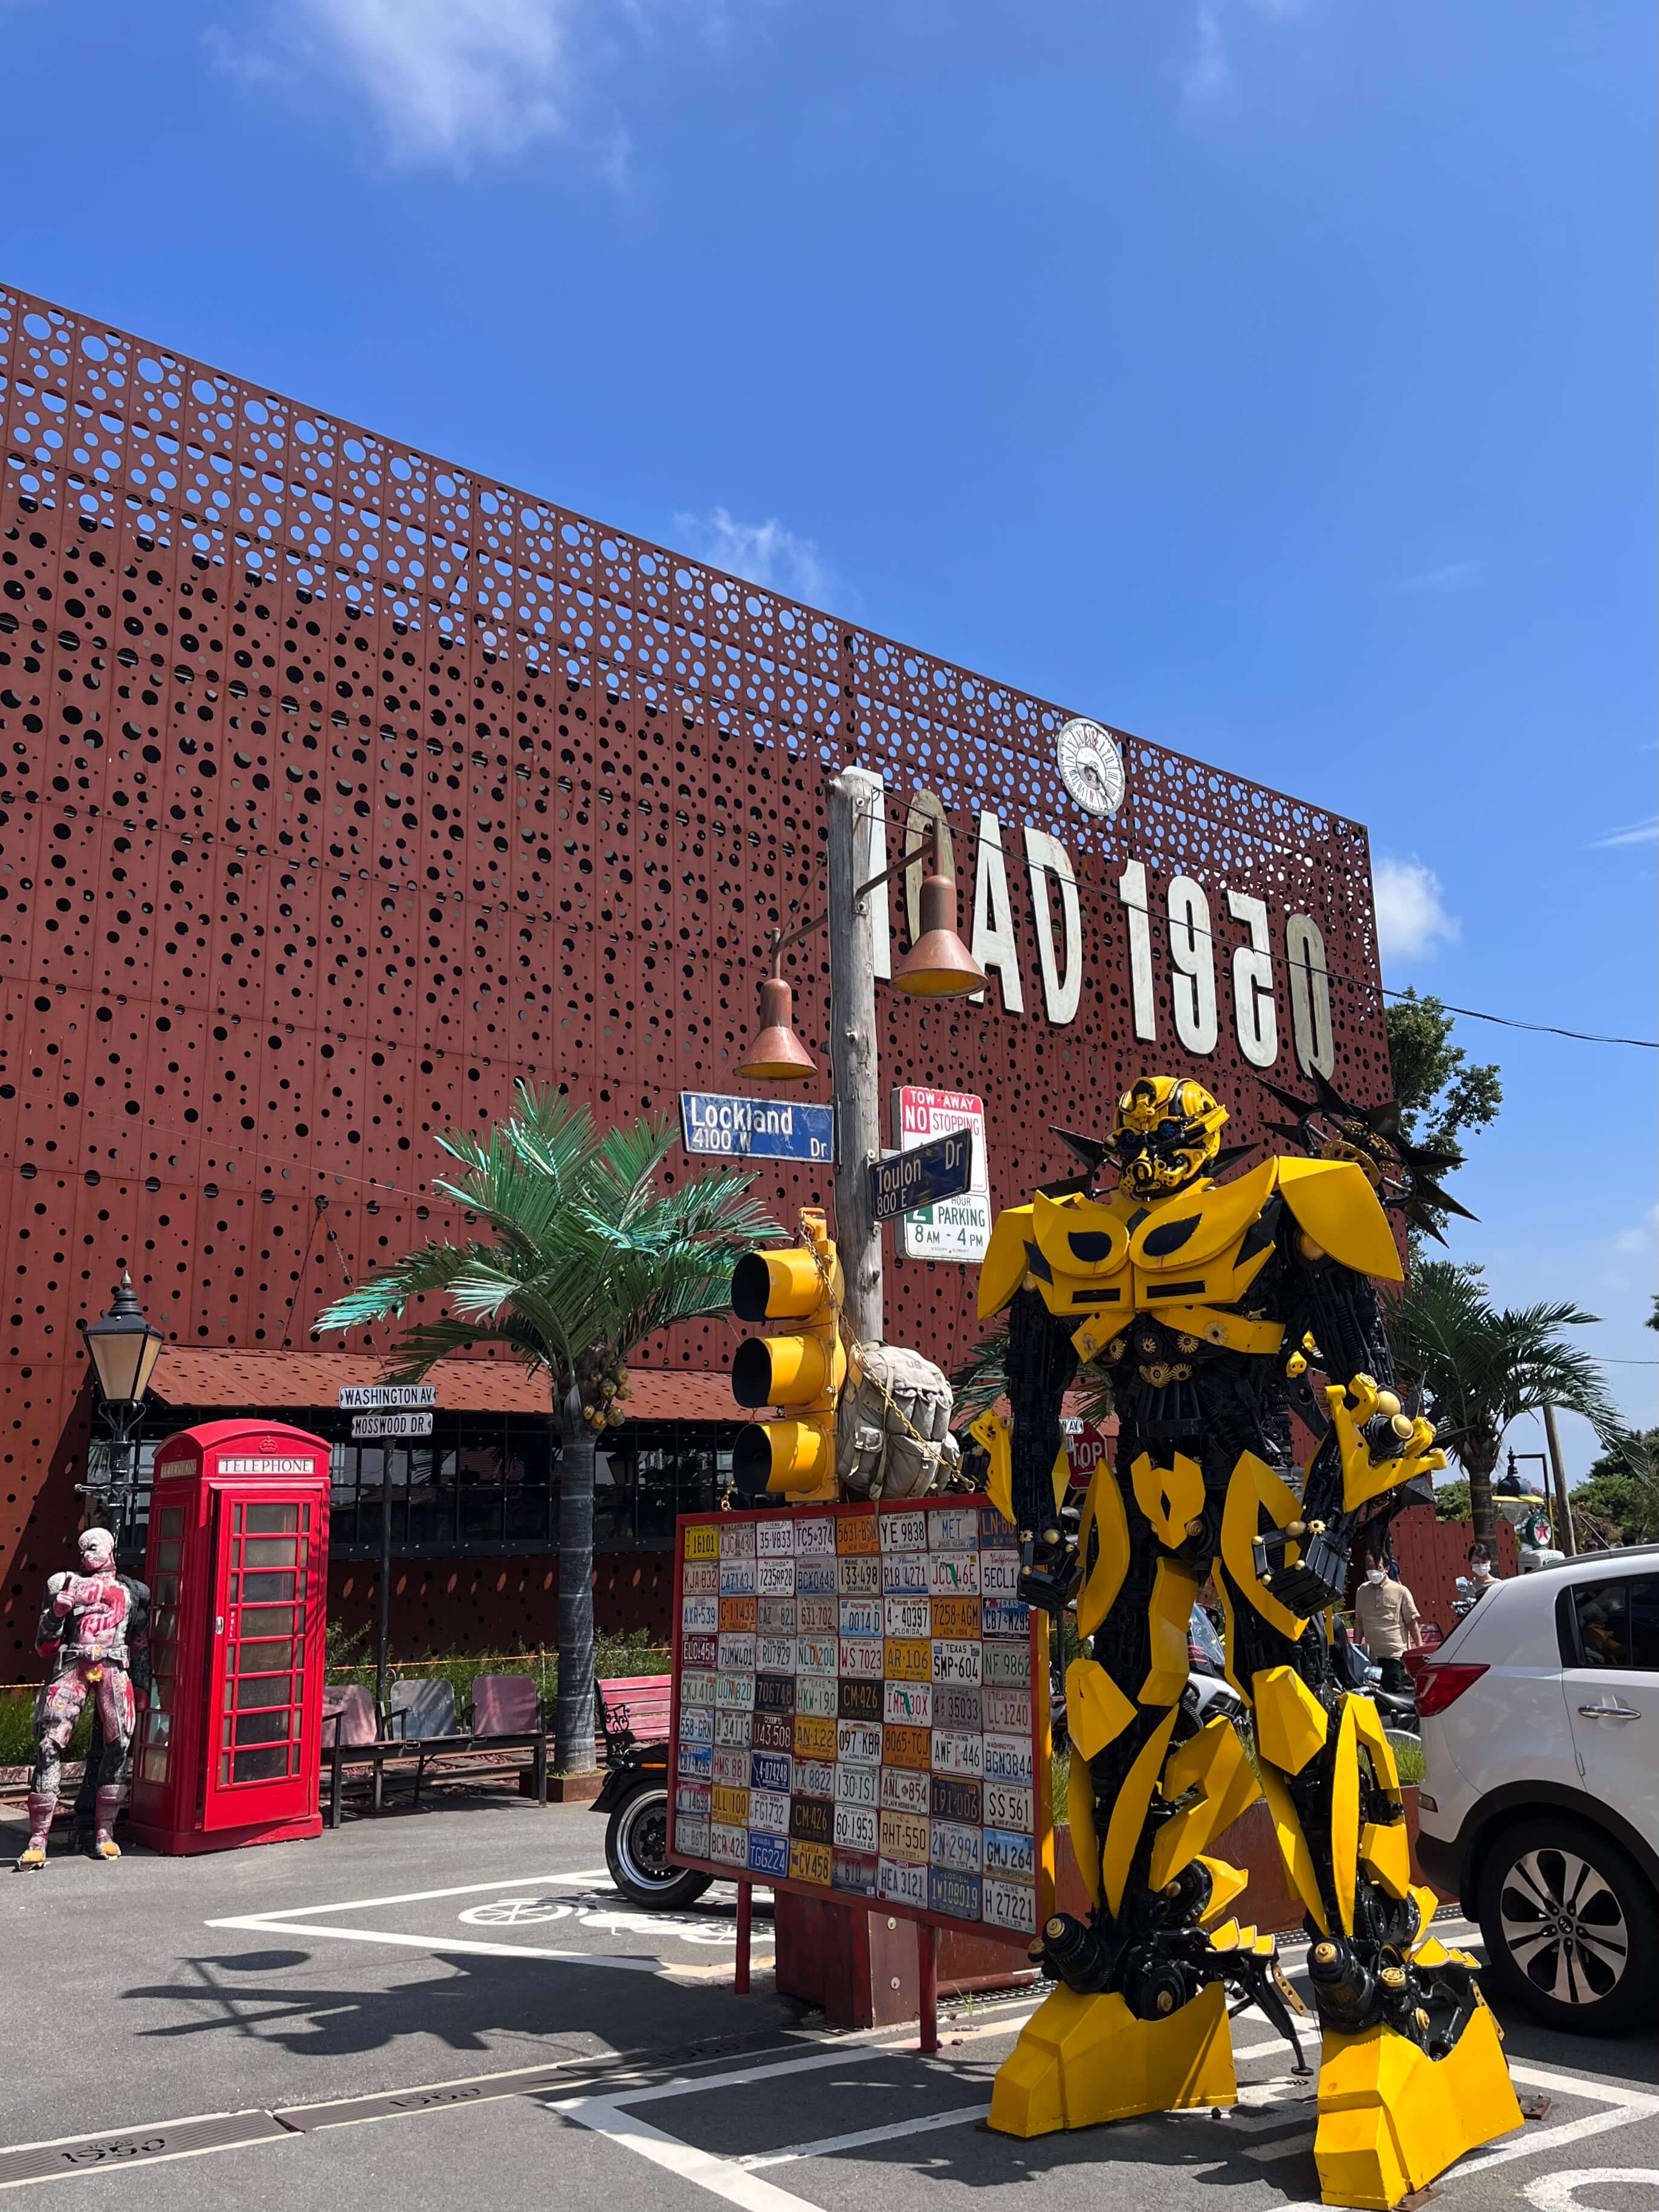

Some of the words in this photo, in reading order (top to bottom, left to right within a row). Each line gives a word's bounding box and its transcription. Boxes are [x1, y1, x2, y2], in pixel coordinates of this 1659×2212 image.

[842, 766, 1084, 1026] OAD
[910, 1091, 974, 1111] TOW-AWAY
[691, 1098, 793, 1136] Lockland
[810, 1138, 827, 1157] Dr
[905, 1105, 927, 1131] NO
[933, 1113, 979, 1136] STOPPING
[692, 1128, 732, 1148] 4100
[739, 1132, 752, 1151] W
[876, 1158, 922, 1193] Toulon
[945, 1139, 964, 1171] Dr
[876, 1193, 896, 1217] 800
[901, 1188, 908, 1208] E
[951, 1196, 971, 1206] HOUR
[938, 1206, 985, 1227] PARKING
[915, 1225, 923, 1243] 8
[927, 1231, 940, 1243] AM
[957, 1228, 966, 1245] 4
[970, 1234, 983, 1246] PM
[345, 1389, 417, 1405] WASHINGTON
[355, 1418, 406, 1435] MOSSWOOD
[1073, 1442, 1103, 1467] TOP
[223, 1459, 311, 1473] TELEPHONE
[818, 1526, 833, 1546] 374
[881, 1522, 898, 1544] YE
[902, 1521, 924, 1542] 9838
[942, 1519, 961, 1539] MET
[693, 1534, 714, 1553] 16101
[740, 1534, 753, 1553] 430
[798, 1571, 835, 1589] BCX0448
[885, 1567, 899, 1586] R18
[905, 1567, 927, 1586] 4271
[996, 1599, 1018, 1608] TEXAS
[759, 1606, 771, 1625] CAZ
[781, 1607, 794, 1625] 821
[763, 1645, 791, 1665] RU7929
[841, 1647, 856, 1668] WS
[859, 1649, 881, 1669] 7023
[946, 1644, 966, 1653] TEXAS
[986, 1654, 999, 1675] NF
[1004, 1655, 1030, 1677] 9862
[682, 1683, 697, 1701] CKJ
[700, 1683, 714, 1702] 410
[758, 1683, 792, 1705] 706748
[808, 1680, 825, 1688] TEXAS
[948, 1697, 978, 1720] 35033
[934, 1740, 952, 1763] AWF
[962, 1744, 980, 1767] 446
[986, 1750, 1032, 1778] BGN3844
[714, 1756, 729, 1776] HMS
[732, 1759, 746, 1779] 881
[795, 1767, 806, 1788] YX
[809, 1768, 831, 1791] 8822
[884, 1777, 899, 1800] ANL
[909, 1782, 927, 1803] 854
[713, 1789, 726, 1811] JLL
[732, 1793, 745, 1814] 100
[755, 1801, 783, 1824] FG1732
[989, 1792, 1005, 1820] SS
[1010, 1797, 1029, 1823] 561
[730, 1837, 745, 1858] 428
[752, 1837, 771, 1845] NEVADA
[801, 1844, 819, 1852] ALASKA
[843, 1837, 866, 1848] NEBRASKA
[751, 1846, 784, 1871] TGG224
[799, 1851, 812, 1875] CV
[813, 1854, 829, 1879] 458
[987, 1842, 1008, 1867] GMJ
[1011, 1846, 1032, 1871] 264
[845, 1861, 861, 1883] 610
[881, 1867, 898, 1892] HEA
[901, 1871, 923, 1898] 3121
[999, 1883, 1019, 1894] MAINE
[986, 1889, 992, 1913] H
[997, 1893, 1033, 1923] 27221
[998, 1916, 1021, 1929] TRAILER
